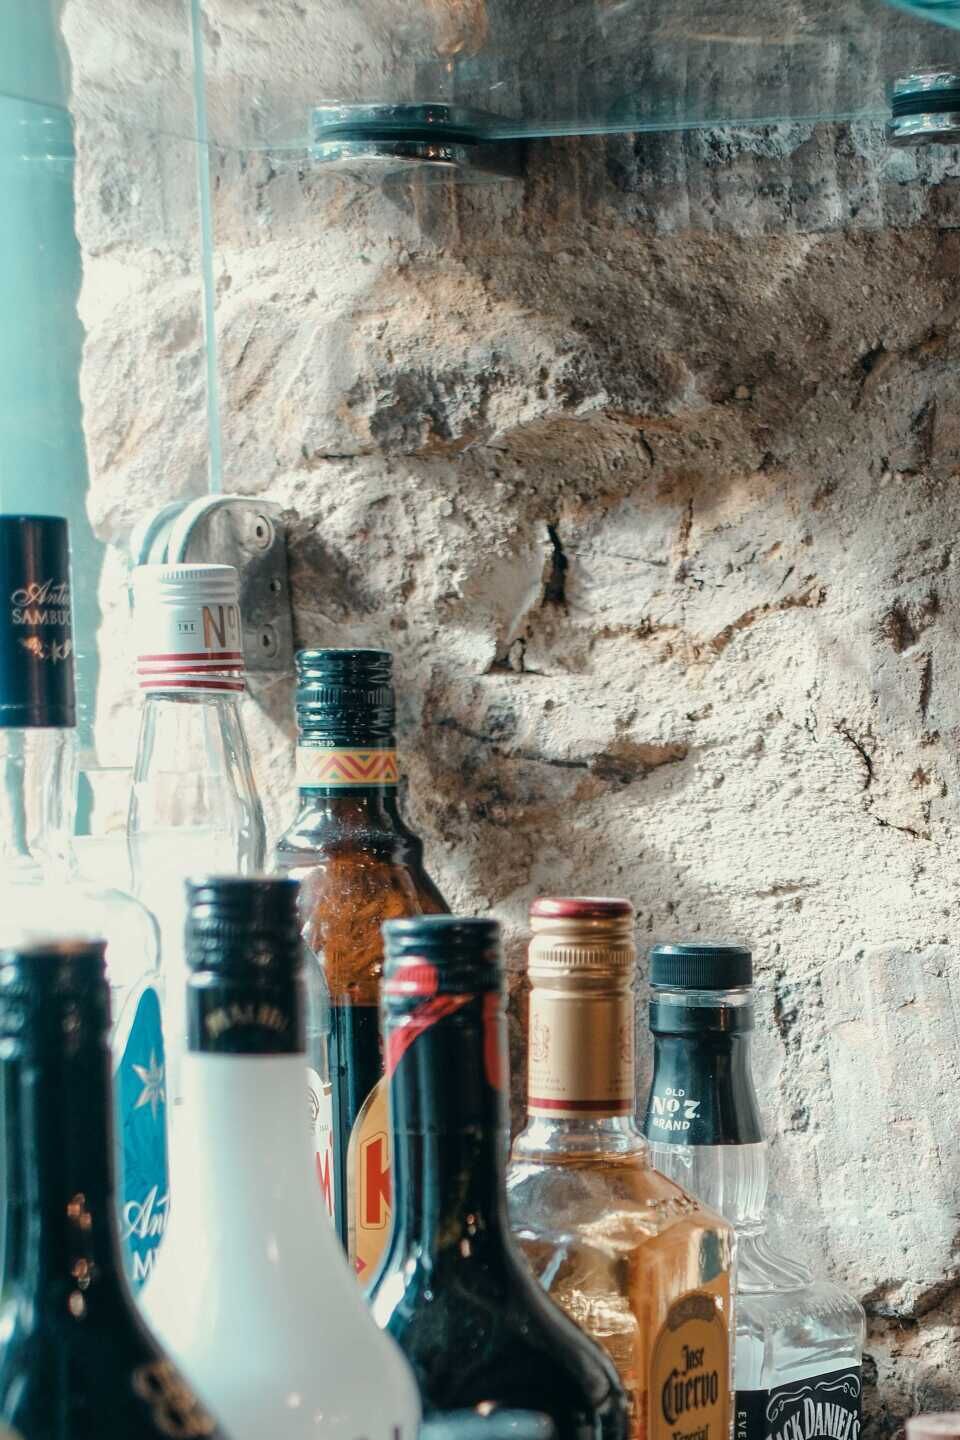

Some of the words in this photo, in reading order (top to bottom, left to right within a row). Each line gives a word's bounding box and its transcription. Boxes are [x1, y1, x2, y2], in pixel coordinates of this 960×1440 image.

[664, 1087, 685, 1097] OLD
[652, 1117, 691, 1131] BRAND
[661, 1367, 718, 1425] Cuervo
